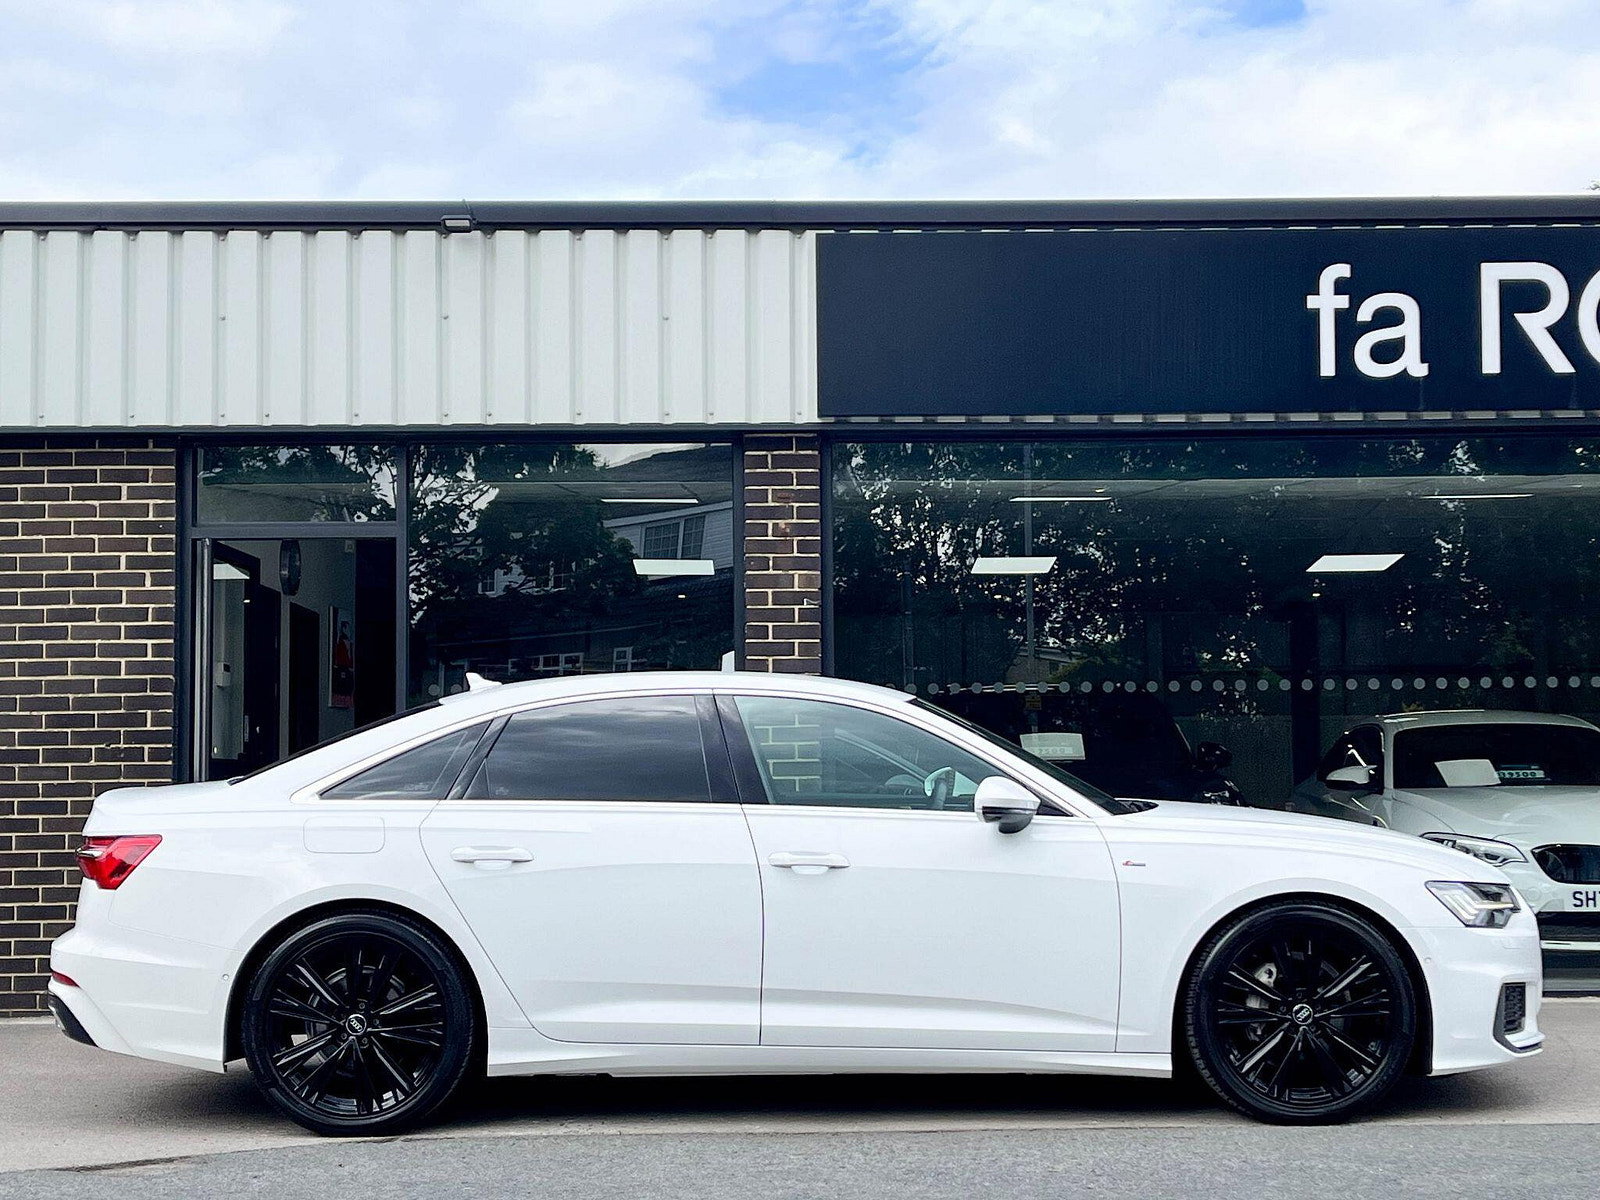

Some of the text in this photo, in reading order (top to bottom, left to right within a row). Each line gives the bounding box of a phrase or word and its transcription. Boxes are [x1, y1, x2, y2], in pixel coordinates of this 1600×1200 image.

[1306, 261, 1600, 378] fa R
[1572, 890, 1600, 908] SH
